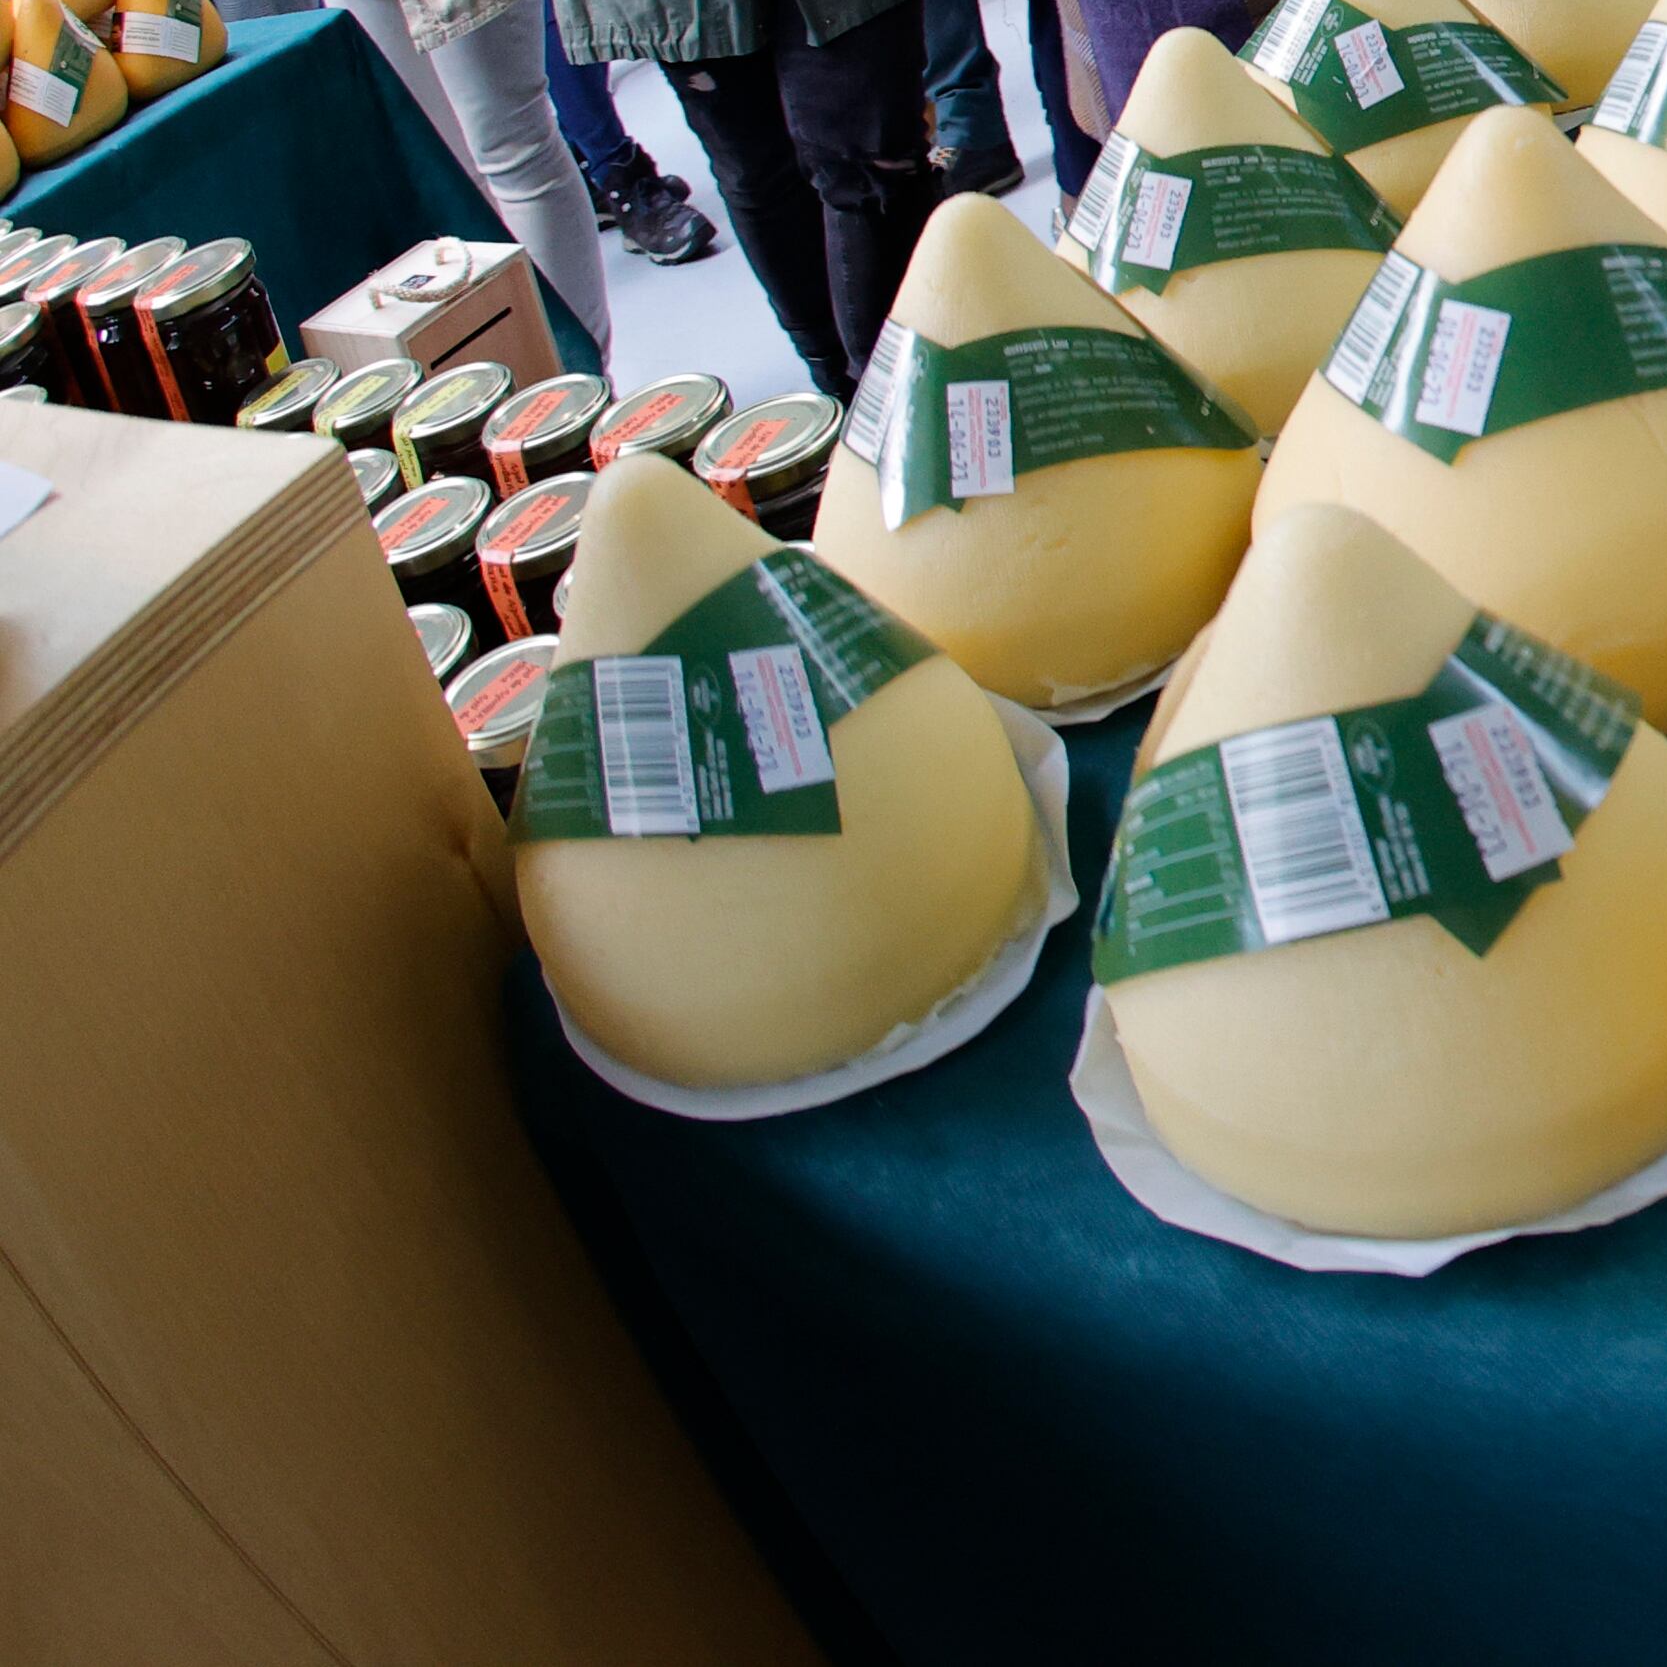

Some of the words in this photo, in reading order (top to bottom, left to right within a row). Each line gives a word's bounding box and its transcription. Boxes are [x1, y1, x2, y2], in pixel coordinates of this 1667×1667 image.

[1124, 181, 1154, 251] 14-06-23
[1158, 188, 1182, 240] 233903
[984, 396, 1001, 458] 233903
[1487, 720, 1543, 812] 233903
